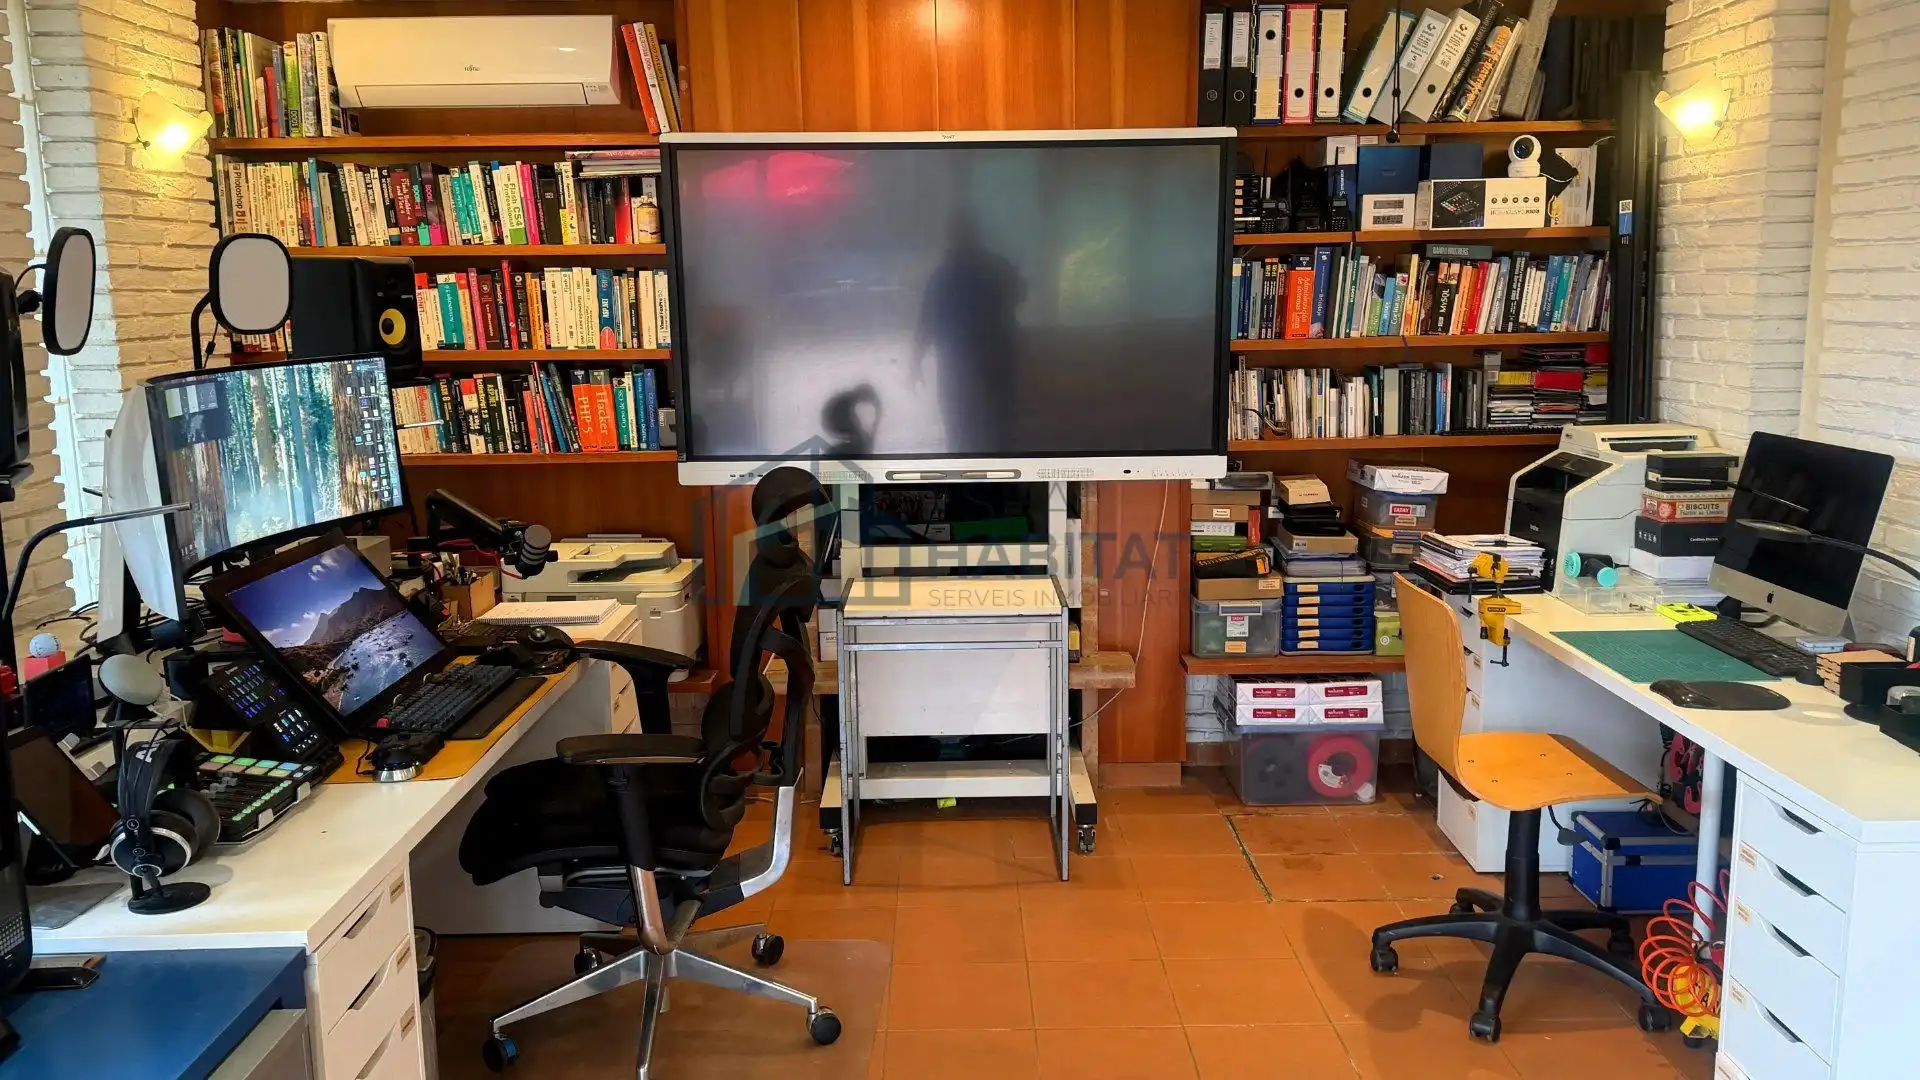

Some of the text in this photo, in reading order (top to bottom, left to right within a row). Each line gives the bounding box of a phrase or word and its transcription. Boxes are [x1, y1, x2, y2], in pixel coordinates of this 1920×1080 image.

[234, 171, 244, 209] Photoshop
[503, 183, 515, 228] Professional
[509, 183, 523, 226] Flash CS4
[417, 291, 425, 313] LINUX
[628, 277, 636, 304] FIREWALL
[1439, 288, 1449, 313] MySQL
[601, 298, 609, 318] ASP.NET
[439, 379, 448, 396] FLASH
[577, 396, 590, 423] PHP
[595, 392, 610, 435] Hacker
